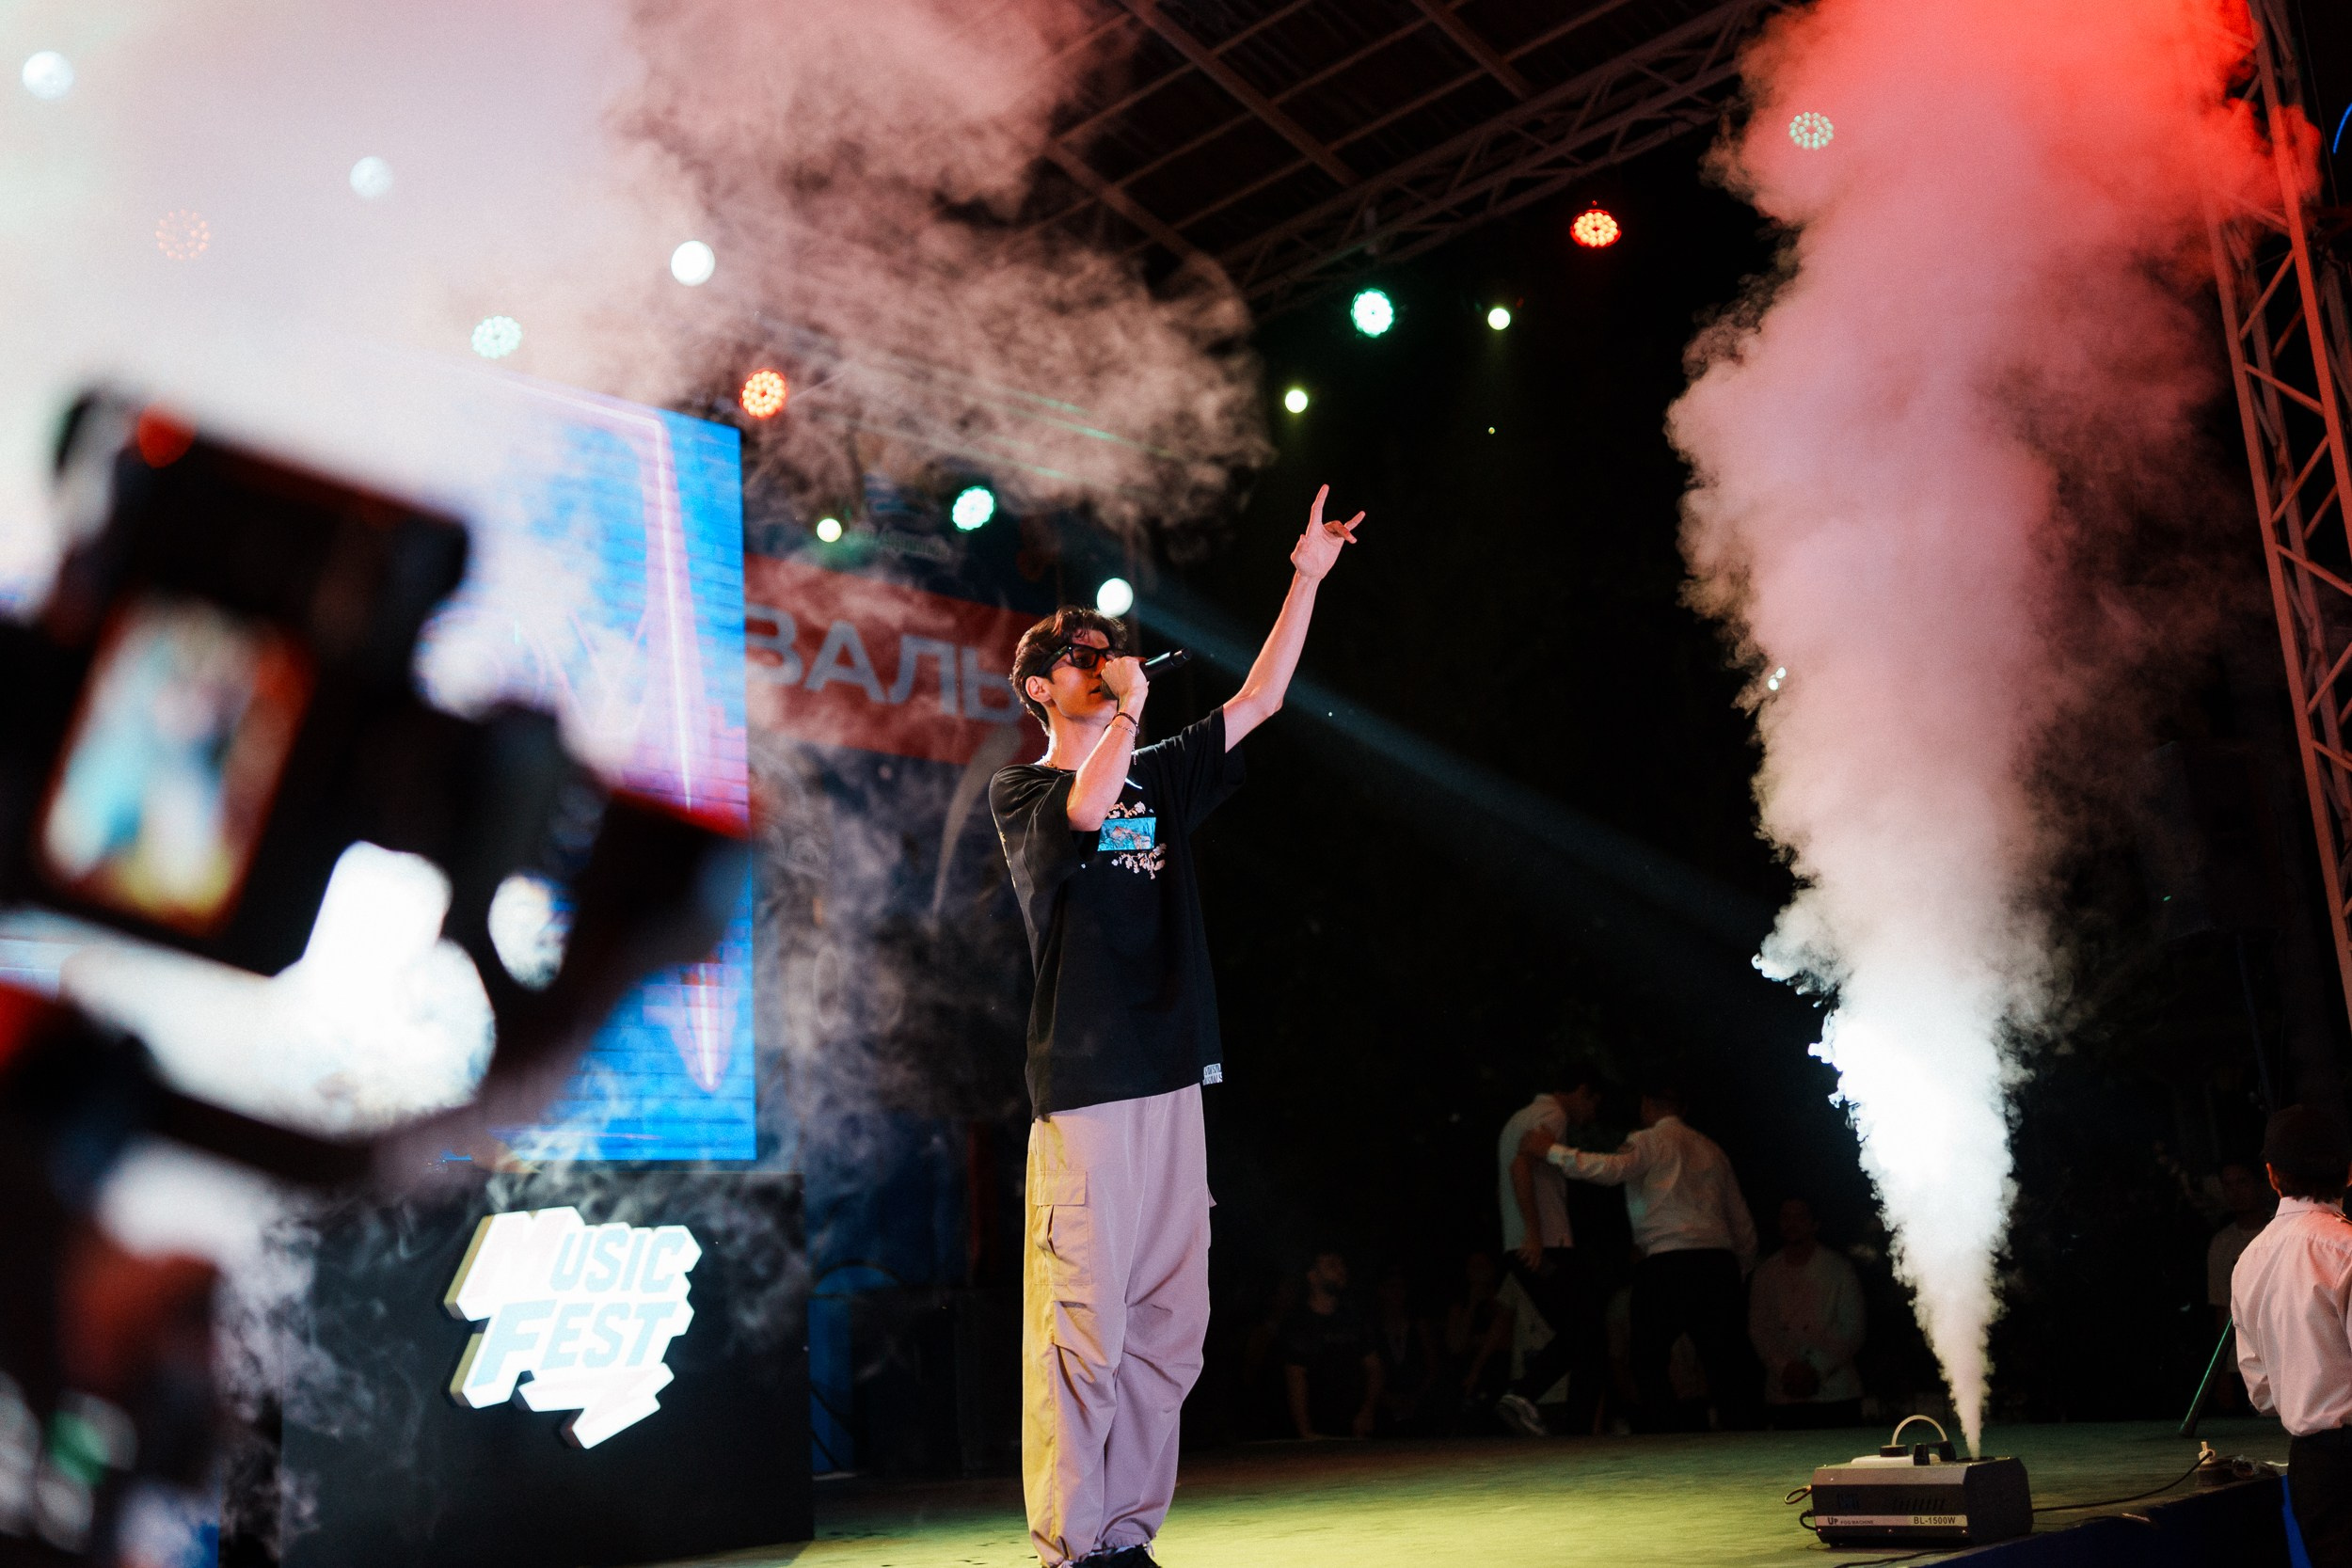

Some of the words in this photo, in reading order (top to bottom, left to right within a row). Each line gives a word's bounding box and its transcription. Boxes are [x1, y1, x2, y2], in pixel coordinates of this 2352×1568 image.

[465, 1213, 688, 1298] MUSIC
[470, 1299, 678, 1388] FEST
[1914, 1516, 1956, 1525] BL-1500W
